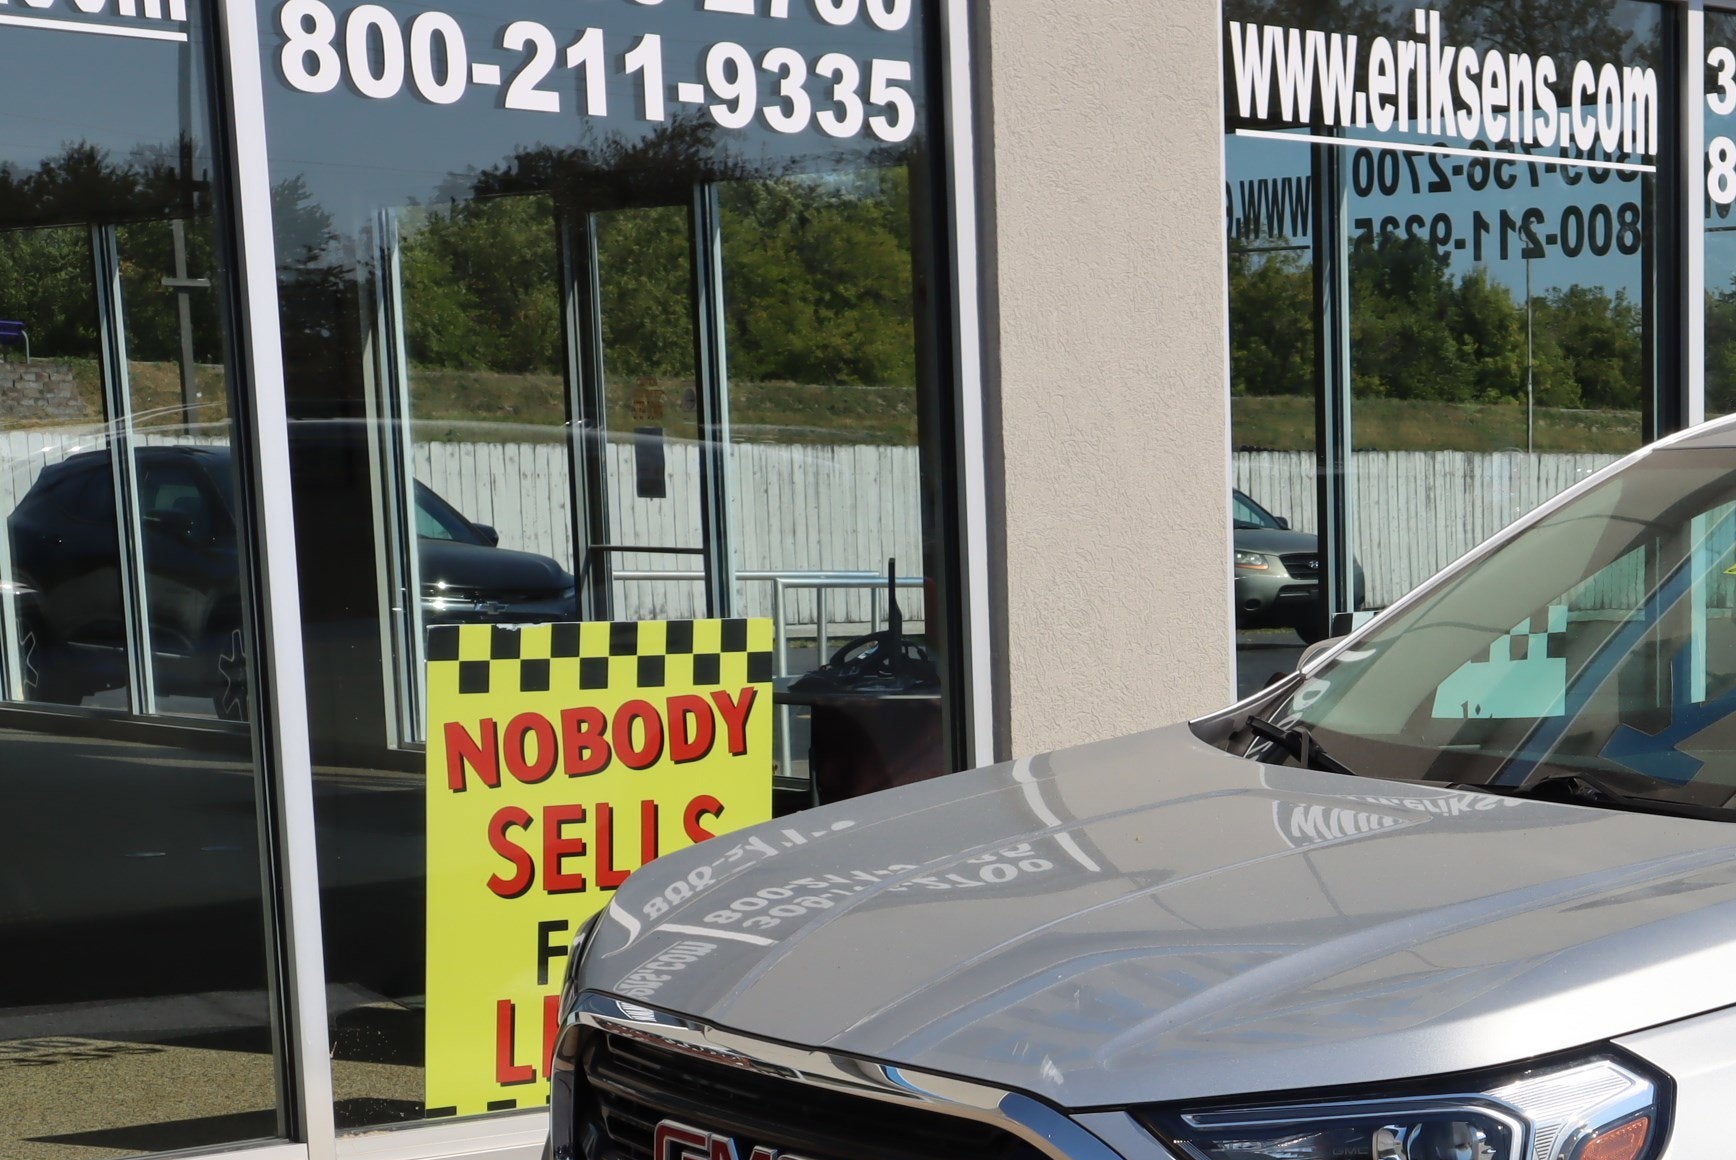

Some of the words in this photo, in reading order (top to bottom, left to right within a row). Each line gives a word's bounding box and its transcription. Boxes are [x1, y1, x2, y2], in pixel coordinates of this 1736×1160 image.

[280, 0, 915, 142] 800-211-9335
[1230, 10, 1657, 155] www.eriksens.com
[444, 687, 757, 792] NOBODY
